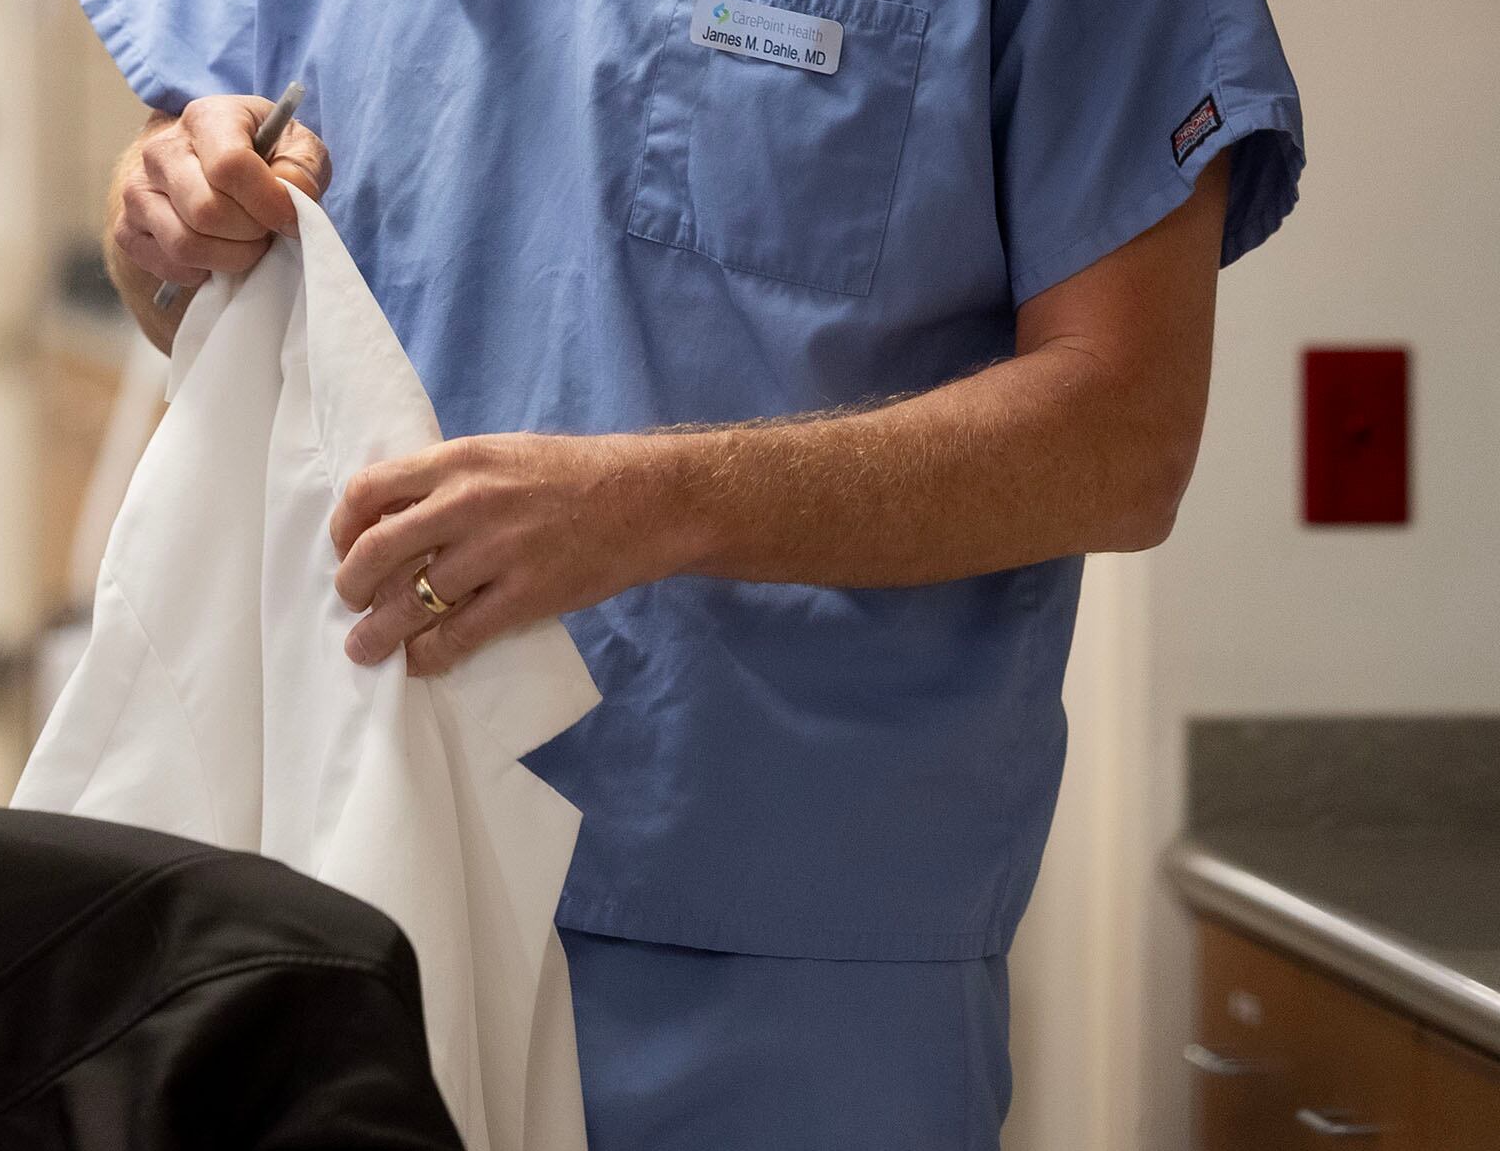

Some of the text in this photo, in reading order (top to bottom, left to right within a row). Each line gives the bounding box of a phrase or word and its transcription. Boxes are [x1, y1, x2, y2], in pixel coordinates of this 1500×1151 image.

[732, 10, 823, 43] CarePoint Health
[702, 26, 826, 66] James M. Dahle, MD
